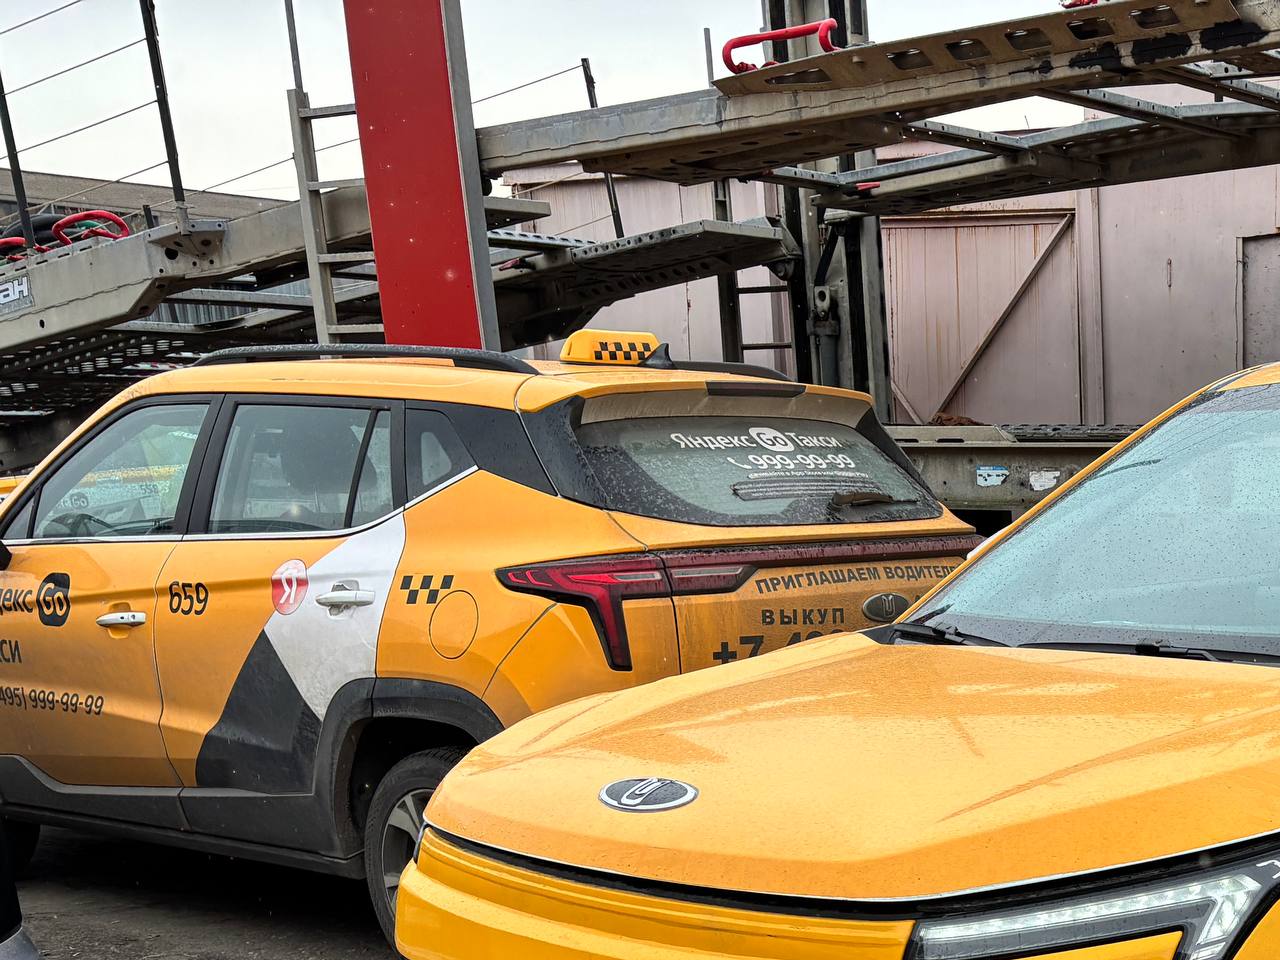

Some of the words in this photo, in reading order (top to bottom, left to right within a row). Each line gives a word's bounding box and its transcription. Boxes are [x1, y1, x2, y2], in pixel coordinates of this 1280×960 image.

[670, 432, 756, 450] Яндекс
[755, 432, 788, 447] Go
[785, 432, 843, 448] Такси
[748, 454, 855, 469] 999-99-99
[755, 565, 881, 594] ПРИГЛАШАЕМ
[0, 587, 33, 614] екс
[40, 582, 68, 616] Go
[168, 580, 209, 616] 659
[761, 607, 845, 626] ВЫКУП
[28, 689, 104, 715] 999-99-99
